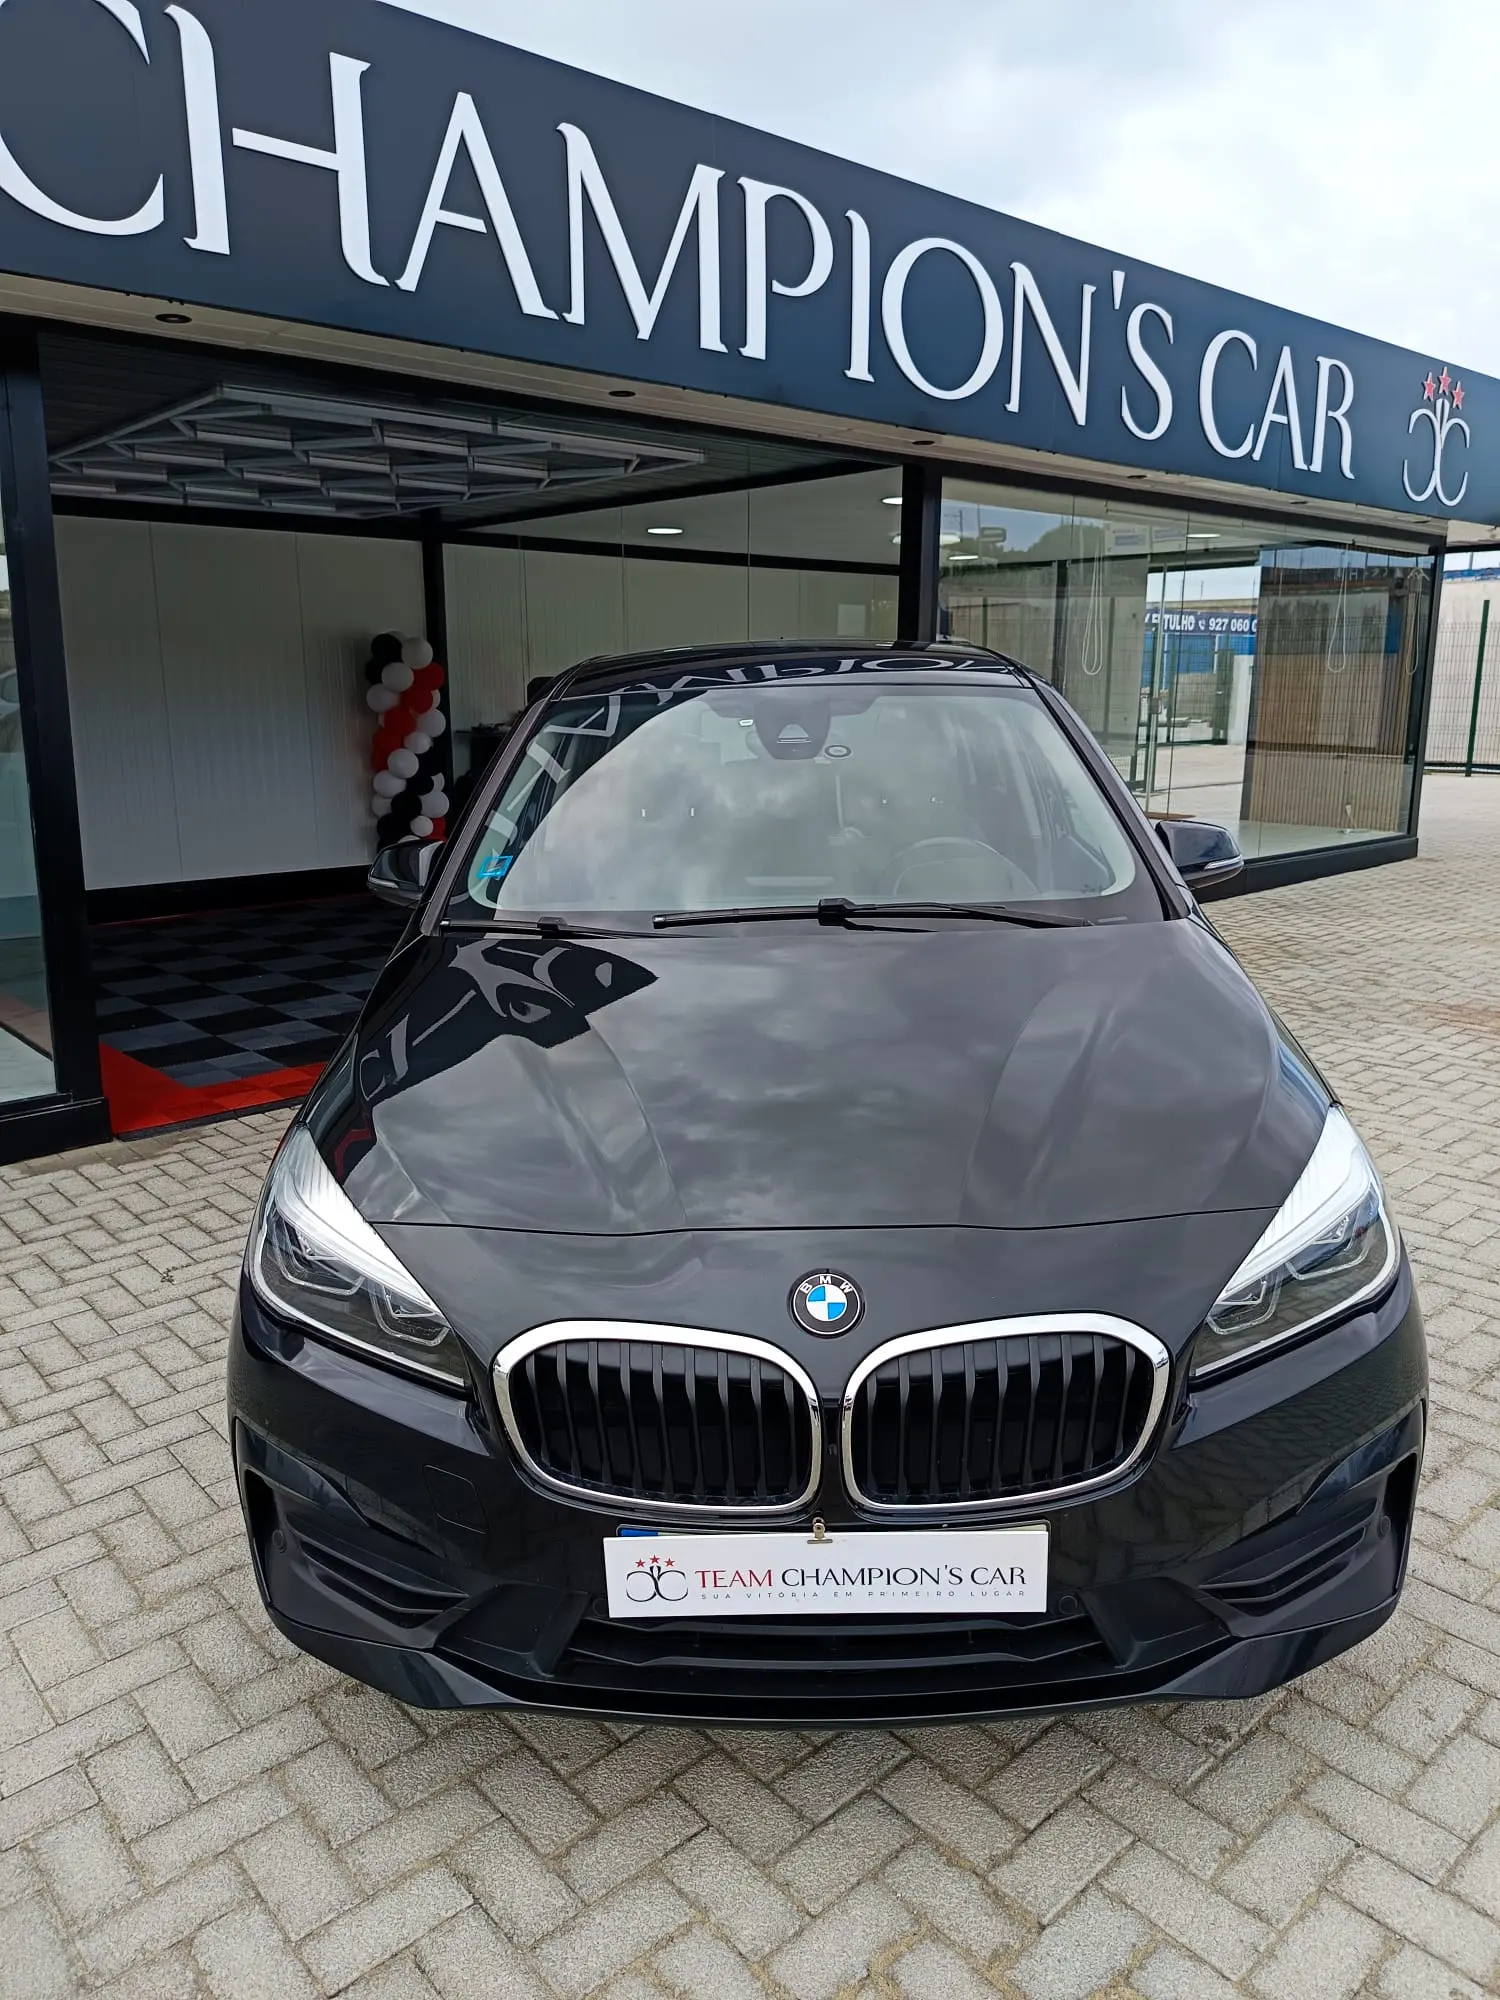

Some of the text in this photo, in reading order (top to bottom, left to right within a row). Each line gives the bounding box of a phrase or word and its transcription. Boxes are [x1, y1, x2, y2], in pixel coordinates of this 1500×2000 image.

[0, 0, 1356, 480] CHAMPION'S CAR
[1208, 617, 1228, 632] 927
[1230, 619, 1250, 632] 060
[799, 1275, 853, 1294] BMW
[694, 1564, 1027, 1588] TEAM CHAMPION'S CAR
[701, 1592, 731, 1600] SUA
[746, 1590, 818, 1599] VITÓRIA
